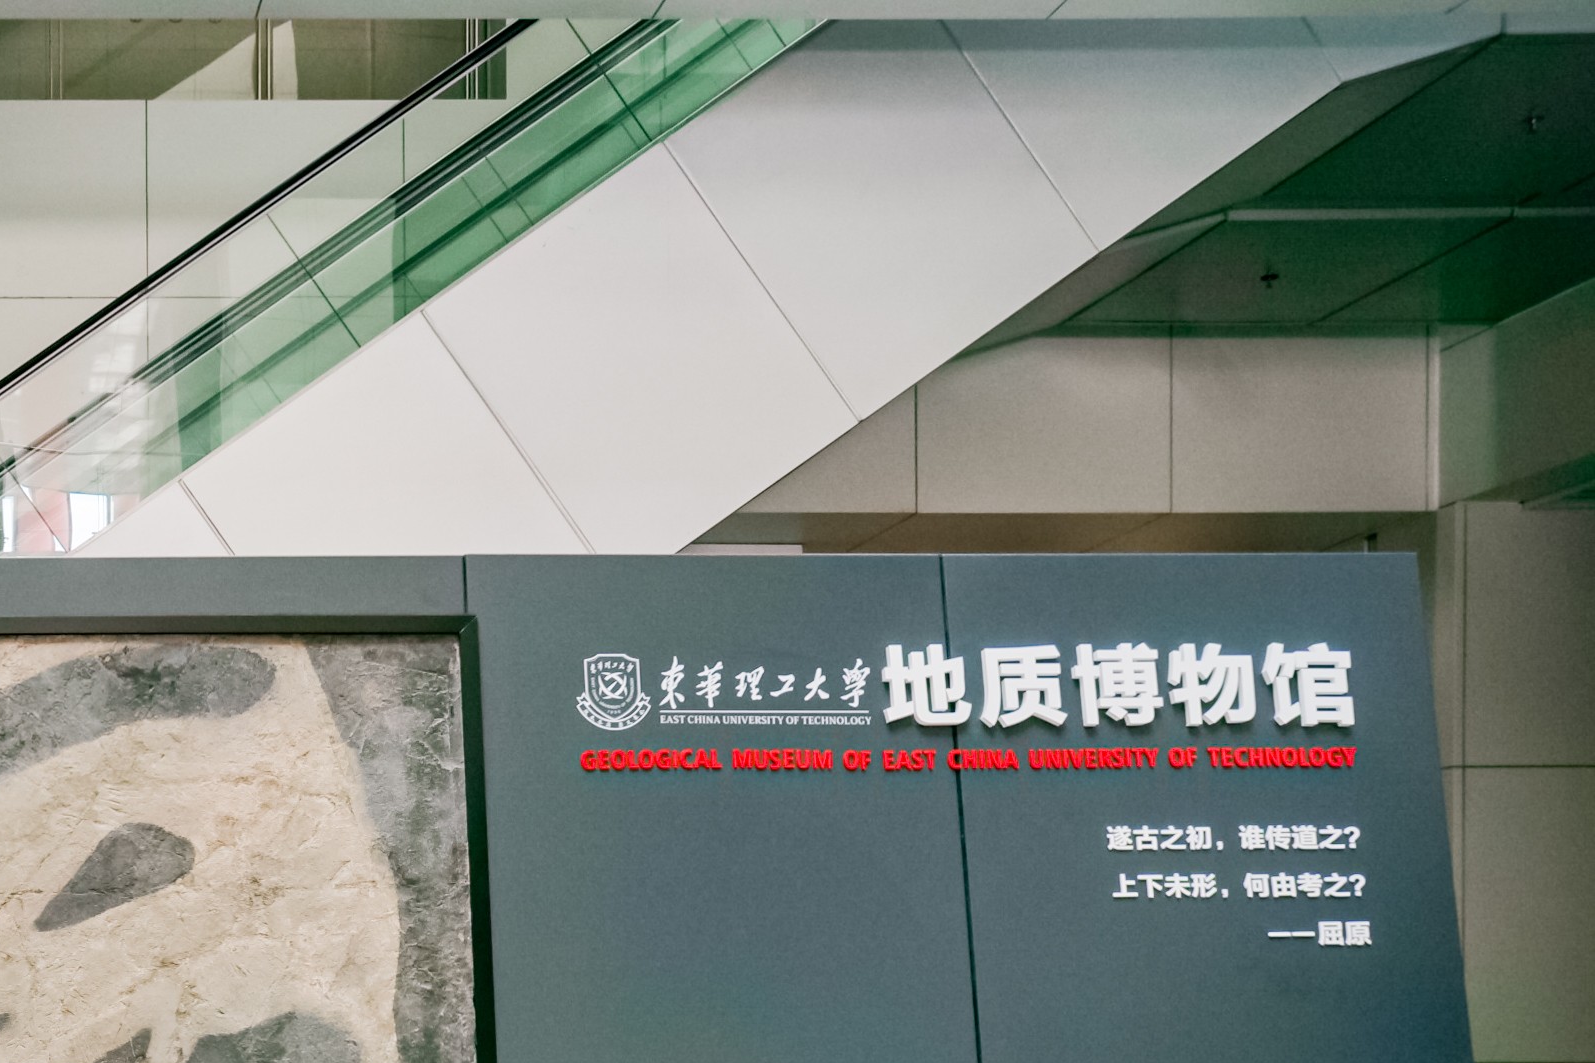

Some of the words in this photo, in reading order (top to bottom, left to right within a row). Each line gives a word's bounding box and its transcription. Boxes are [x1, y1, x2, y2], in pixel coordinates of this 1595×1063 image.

[881, 642, 1356, 728] 地质博物馆
[659, 714, 686, 724] EAST
[687, 714, 721, 725] CHINA
[722, 715, 784, 725] UNIVERSITY
[785, 715, 800, 725] OF
[800, 715, 872, 726] TECHNOLOGY
[580, 748, 723, 771] GEOLOGICAL
[732, 748, 833, 771] MUSEUM
[842, 749, 872, 771] OF
[882, 749, 937, 771] EAST
[946, 748, 1020, 770] CHINA
[1027, 747, 1160, 770] UNIVERSITY
[1167, 747, 1198, 769] OF
[1206, 746, 1358, 769] TECHNOLOGY
